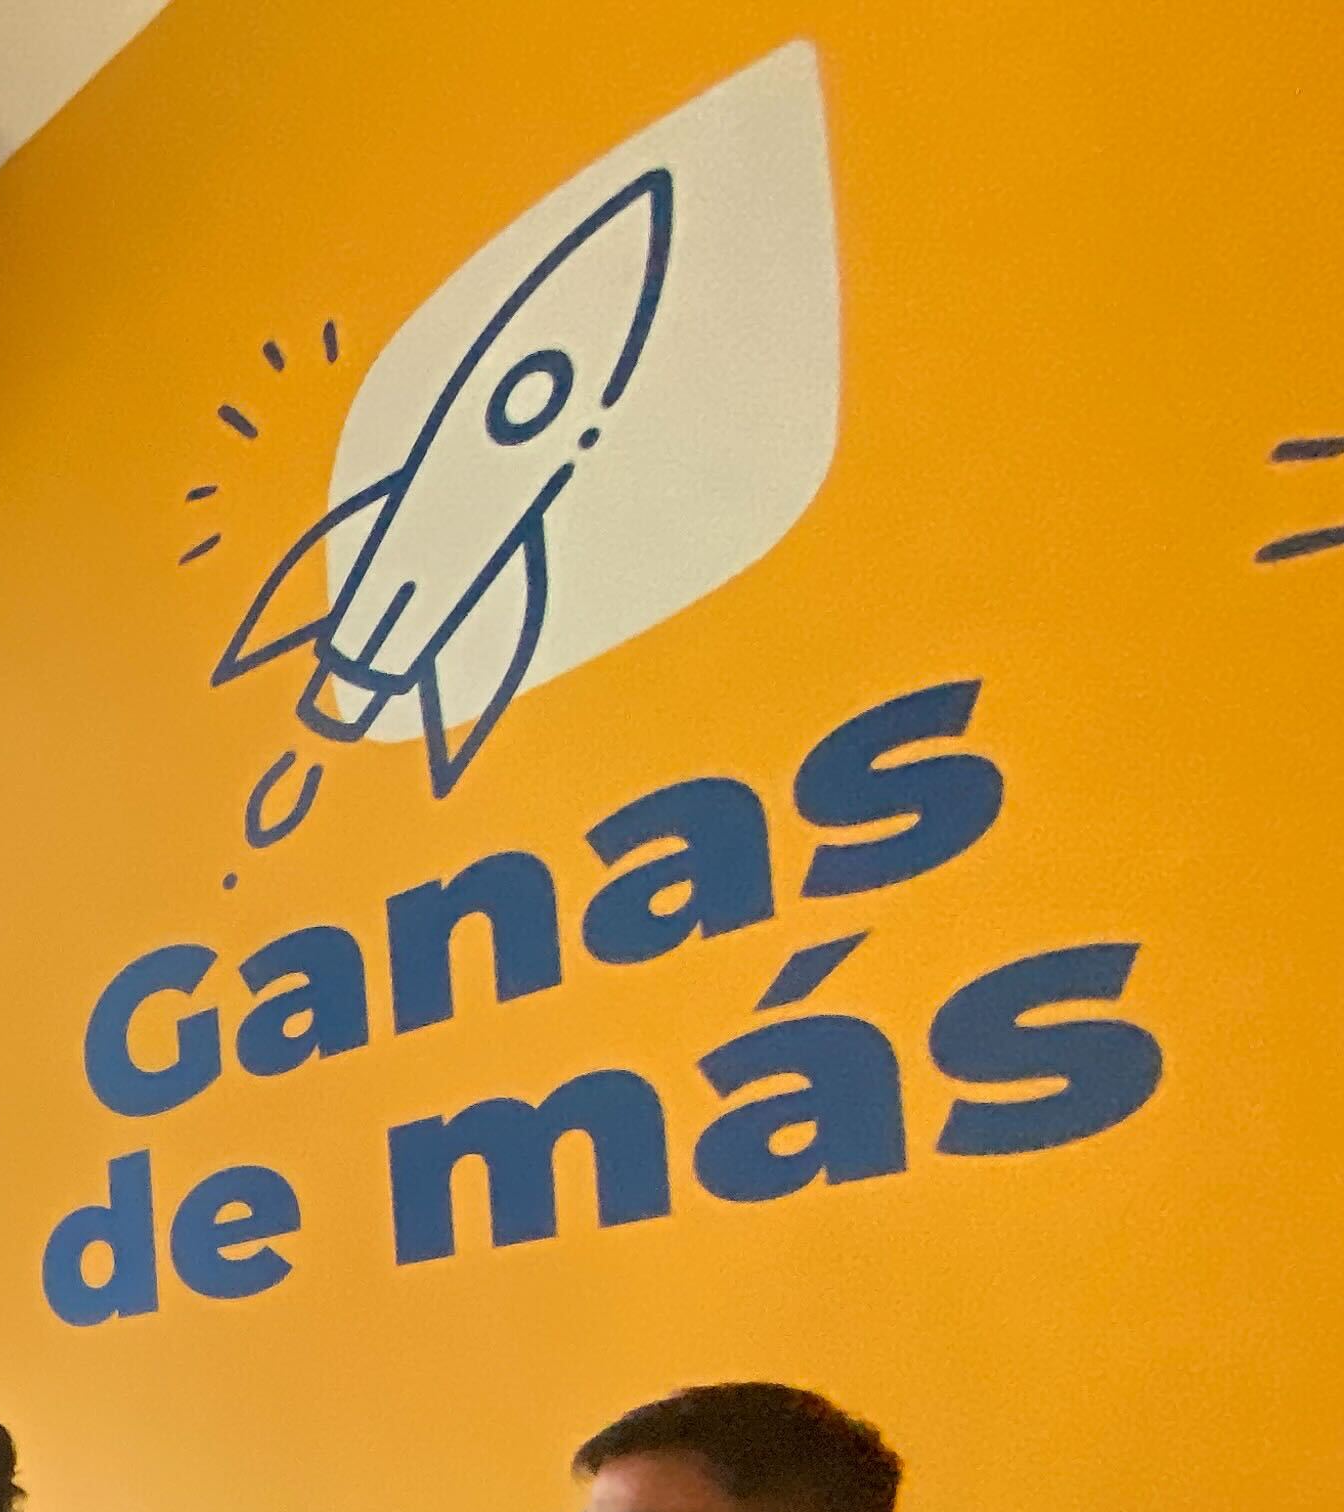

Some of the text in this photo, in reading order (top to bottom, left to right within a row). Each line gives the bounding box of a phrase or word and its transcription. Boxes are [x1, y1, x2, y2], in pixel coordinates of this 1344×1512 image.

[83, 679, 1004, 1118] Ganas
[41, 930, 1164, 1328] de más
